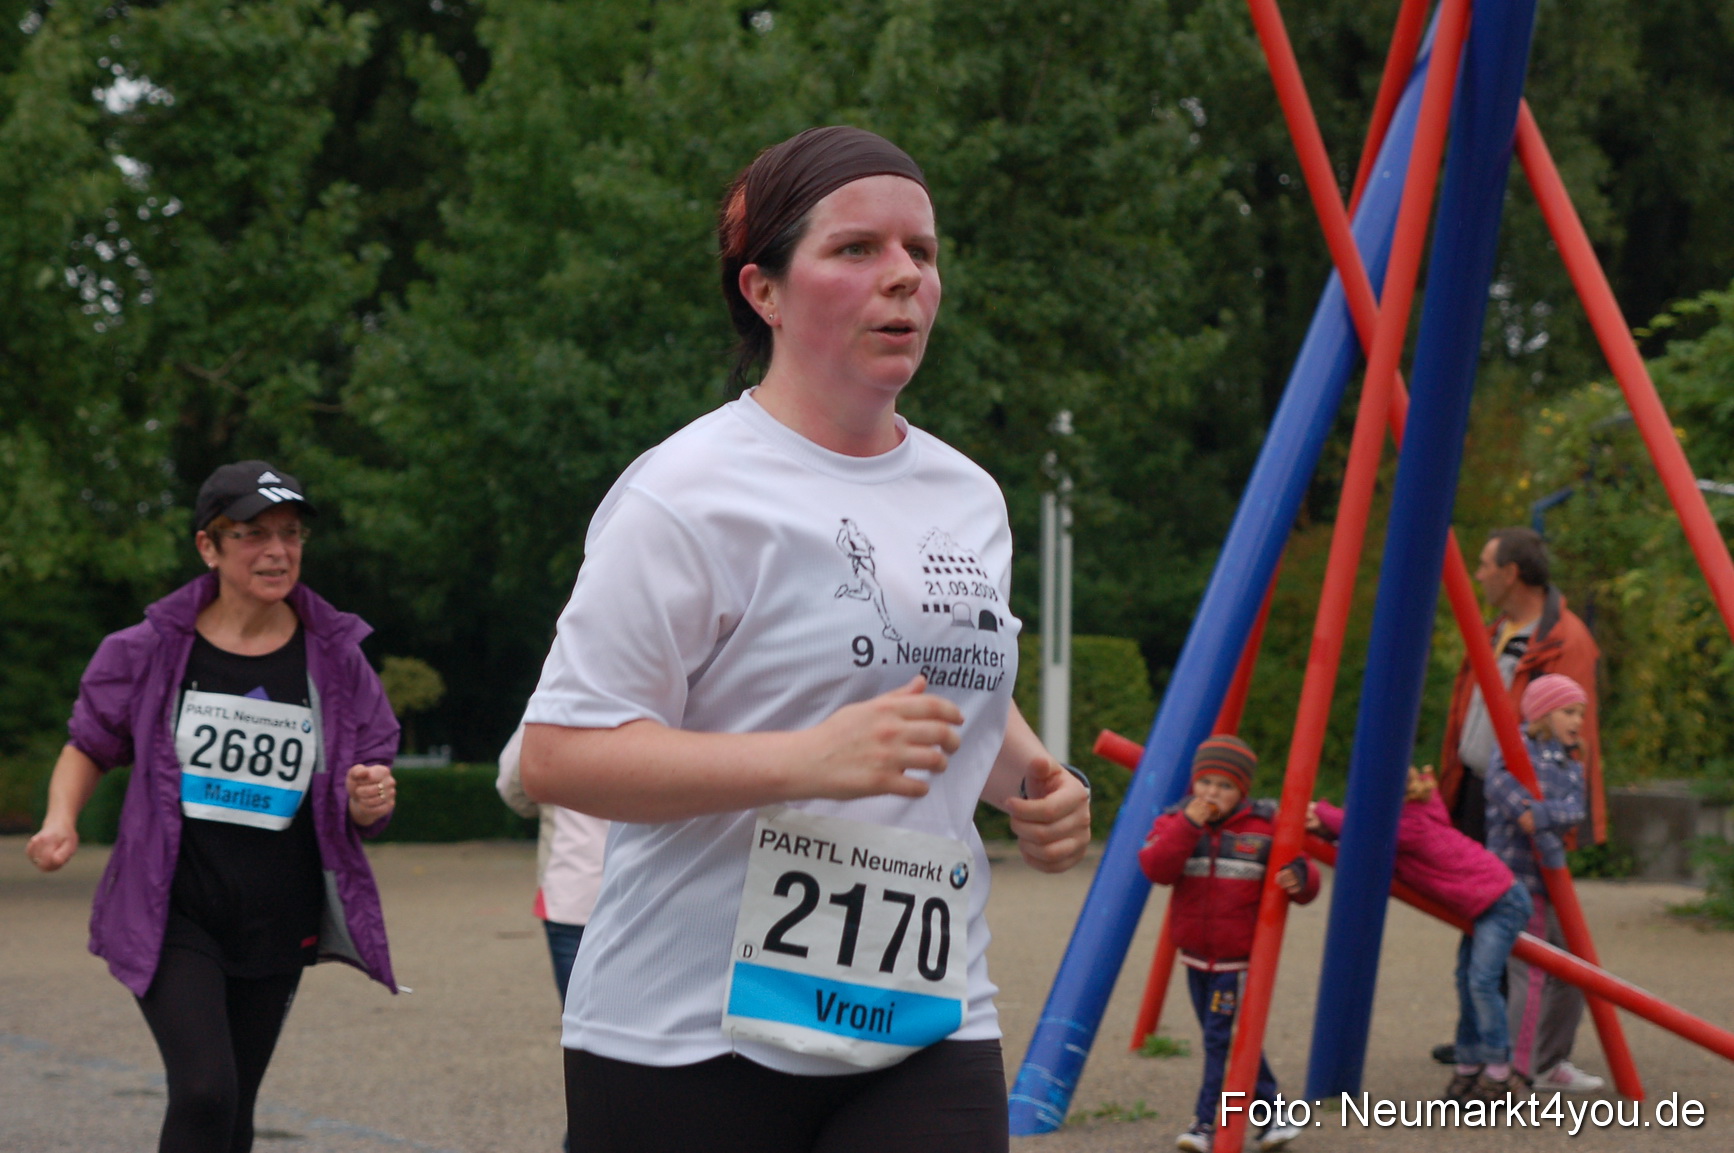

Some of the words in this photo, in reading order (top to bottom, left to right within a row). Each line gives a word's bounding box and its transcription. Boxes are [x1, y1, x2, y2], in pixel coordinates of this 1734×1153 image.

[852, 635, 888, 667] 9.
[896, 642, 1005, 668] Neumarkter
[920, 665, 1005, 692] Stadtlauf
[186, 703, 229, 720] PARTL
[233, 710, 298, 730] Neumarkt
[190, 724, 303, 782] 2689
[204, 783, 272, 810] Marlies
[759, 829, 843, 865] PARTL
[851, 847, 942, 882] Neumarkt
[763, 870, 950, 981] 2170
[816, 989, 896, 1035] Vroni
